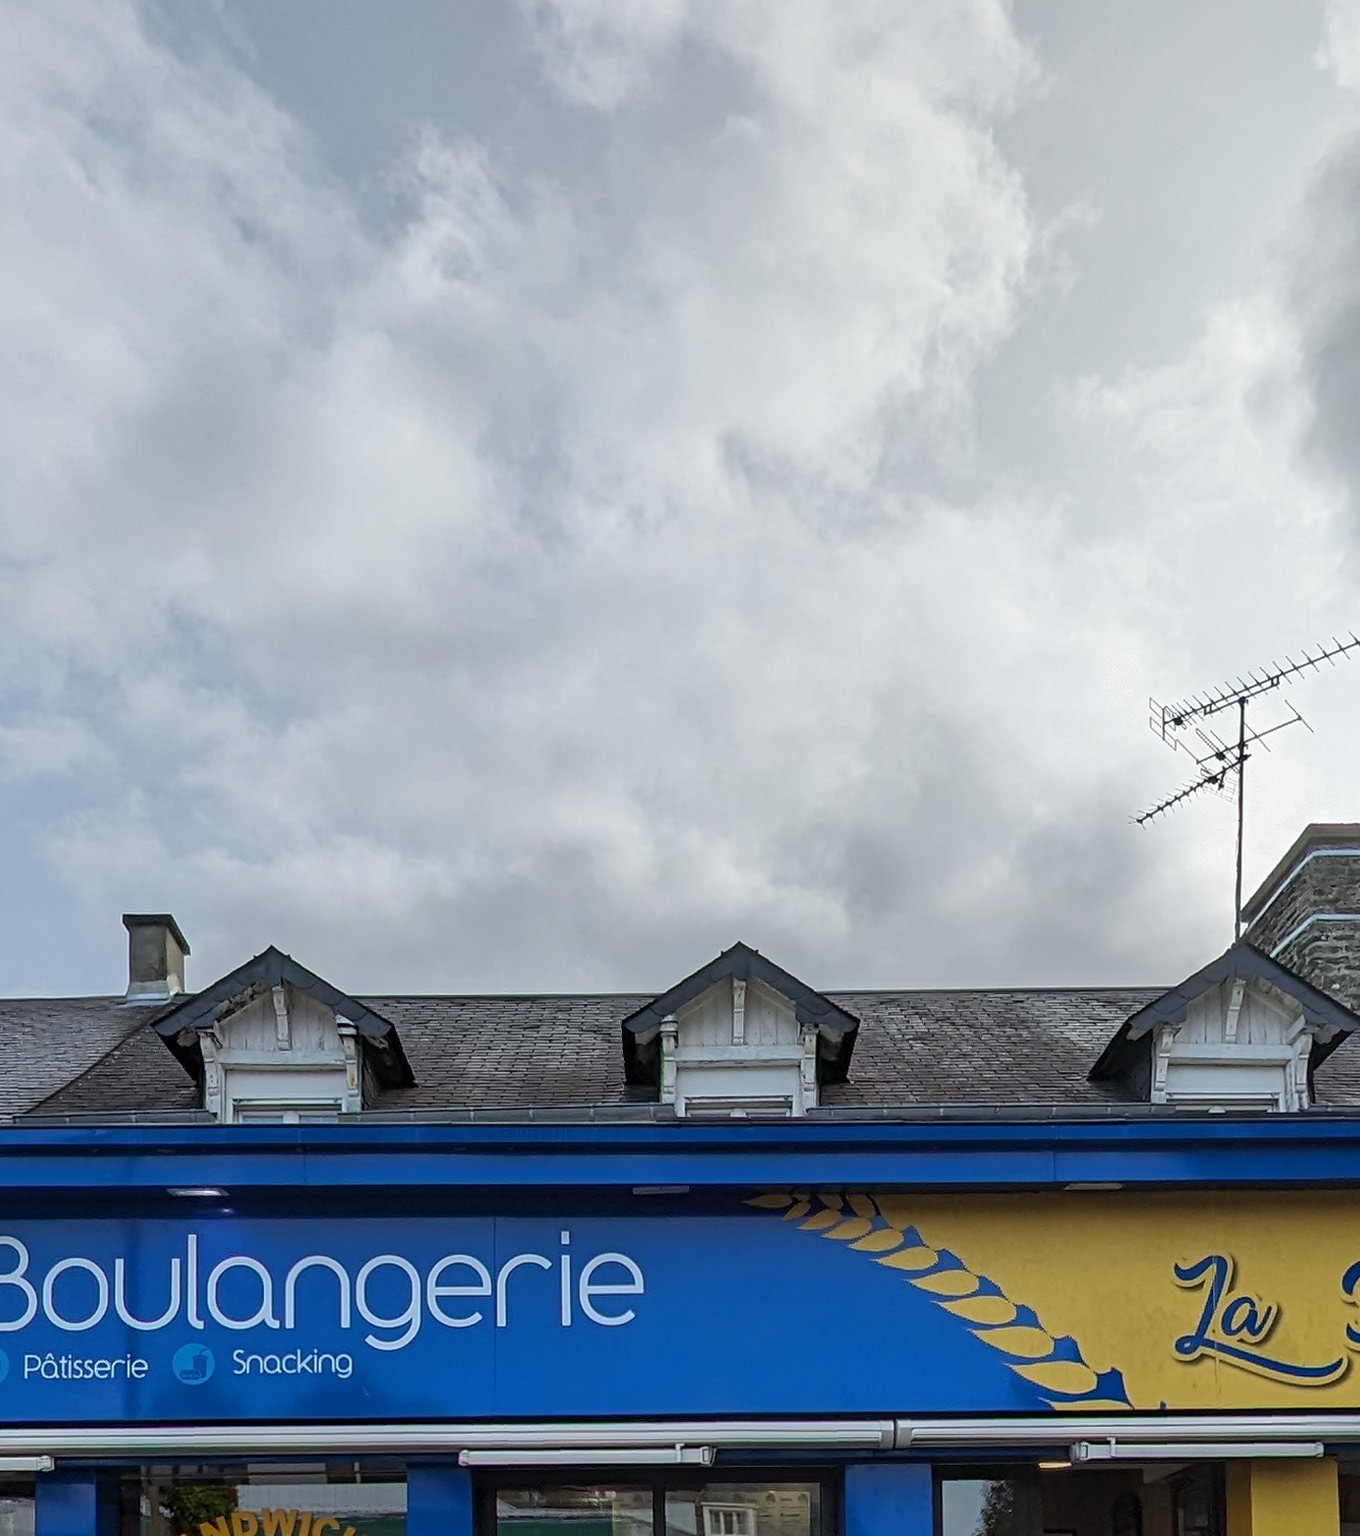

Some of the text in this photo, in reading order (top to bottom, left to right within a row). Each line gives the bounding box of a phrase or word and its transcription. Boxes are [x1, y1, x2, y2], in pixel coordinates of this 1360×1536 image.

[1173, 1254, 1344, 1378] La
[23, 1352, 149, 1381] Pâtisserie
[231, 1348, 354, 1380] Snacking
